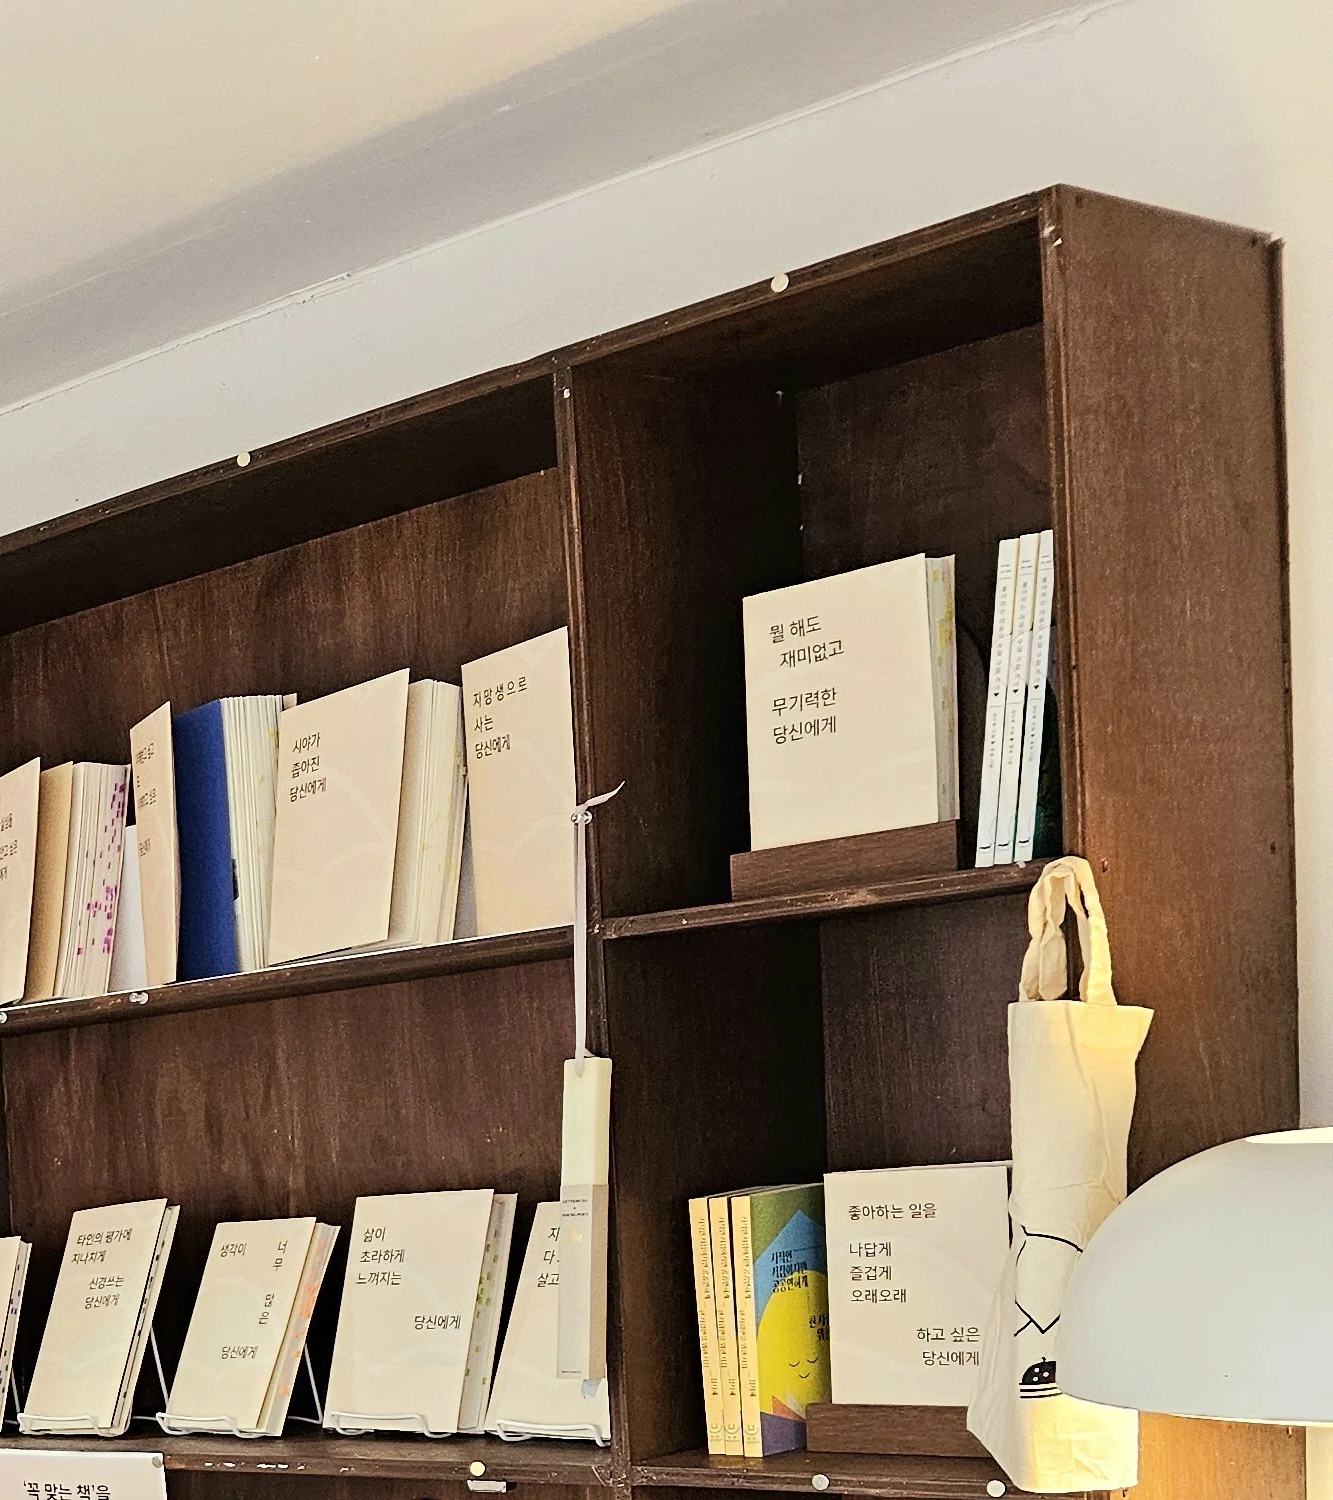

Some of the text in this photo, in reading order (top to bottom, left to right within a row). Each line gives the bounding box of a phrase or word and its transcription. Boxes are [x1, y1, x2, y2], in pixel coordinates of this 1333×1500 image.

[769, 615, 822, 644] 뭘 해도
[775, 639, 845, 668] 재미없고
[771, 687, 837, 721] 무기력한
[474, 716, 494, 732] 사는
[773, 715, 837, 745] 당신에게
[292, 731, 321, 754] 시야가
[475, 734, 511, 760] 당신에게
[291, 755, 320, 779] 좁아진
[289, 777, 327, 803] 당신에게
[848, 1202, 938, 1221] 좋아하는 일을
[76, 1228, 133, 1247] 타인의 평가에
[363, 1226, 386, 1243] 삶이
[71, 1249, 107, 1265] 지나치게
[220, 1243, 247, 1258] 생각이
[359, 1248, 405, 1264] 초라하게
[849, 1241, 892, 1258] 나답게
[356, 1271, 402, 1286] 느껴지는
[849, 1265, 892, 1282] 즐겁게
[89, 1275, 124, 1290] 신경쓰는
[84, 1294, 118, 1310] 당신에게
[850, 1288, 907, 1304] 오래오래
[414, 1314, 461, 1331] 당신에게
[916, 1326, 981, 1343] 하고 싶은
[221, 1345, 259, 1360] 당신에게
[922, 1350, 980, 1367] 당신에게
